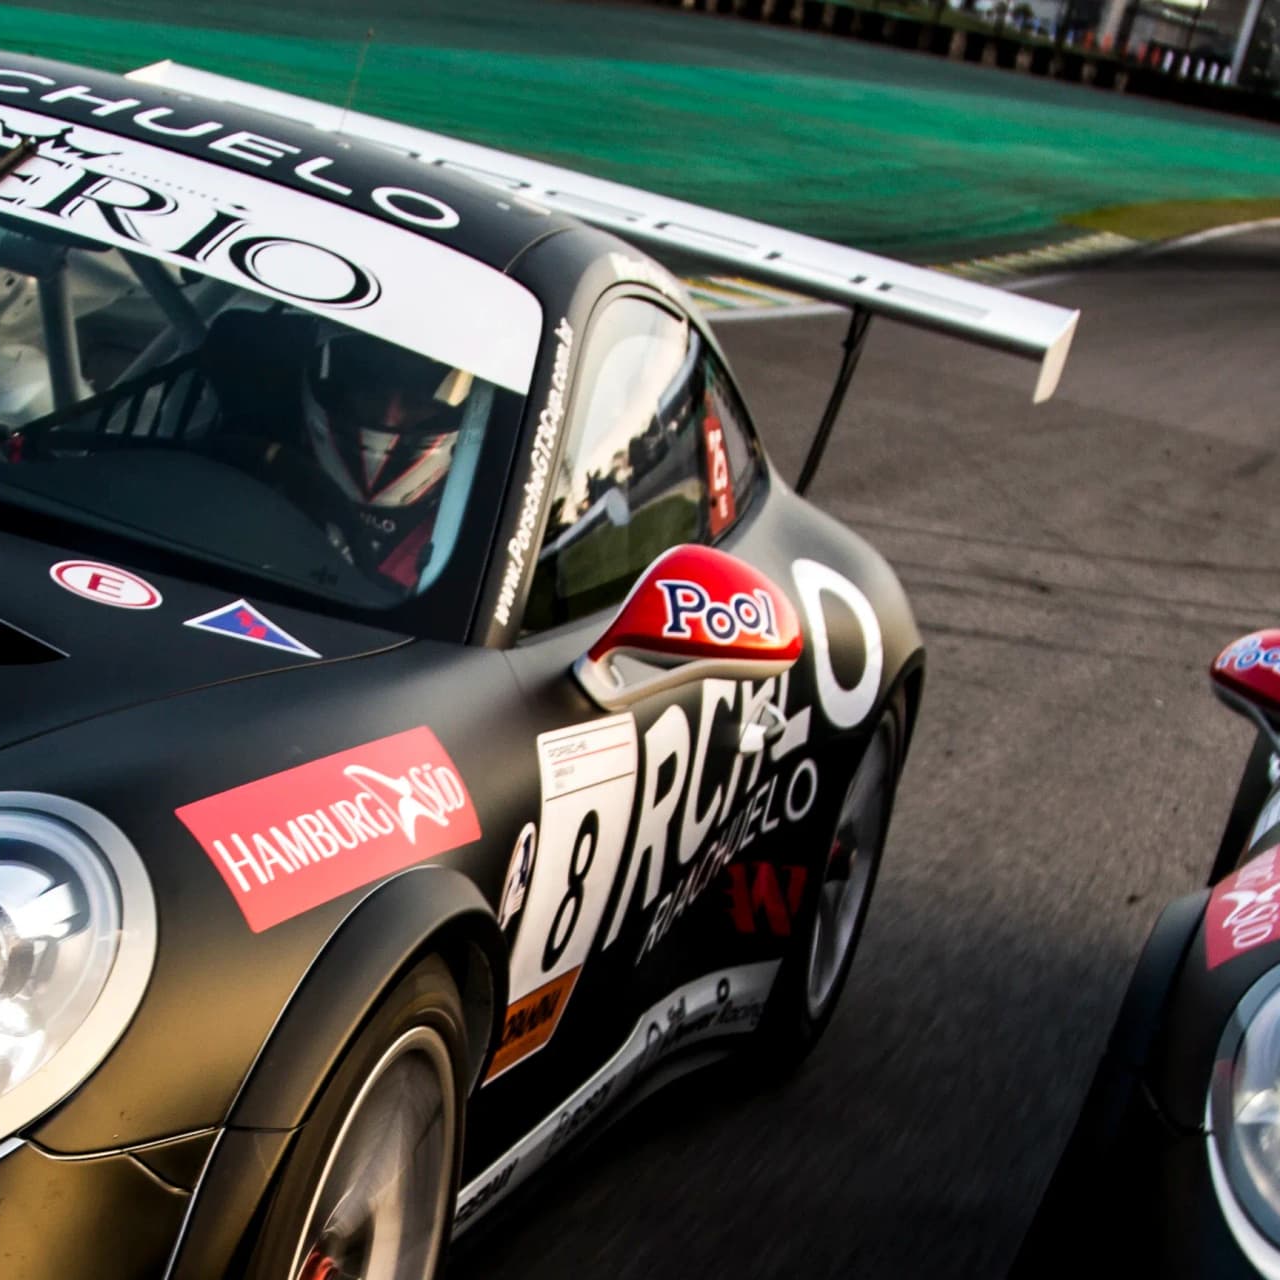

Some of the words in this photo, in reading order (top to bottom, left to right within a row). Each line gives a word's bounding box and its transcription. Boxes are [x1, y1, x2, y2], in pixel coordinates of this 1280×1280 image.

[87, 573, 125, 599] E
[656, 579, 778, 644] Pool
[213, 792, 395, 893] HAMBURG
[542, 810, 599, 972] 8
